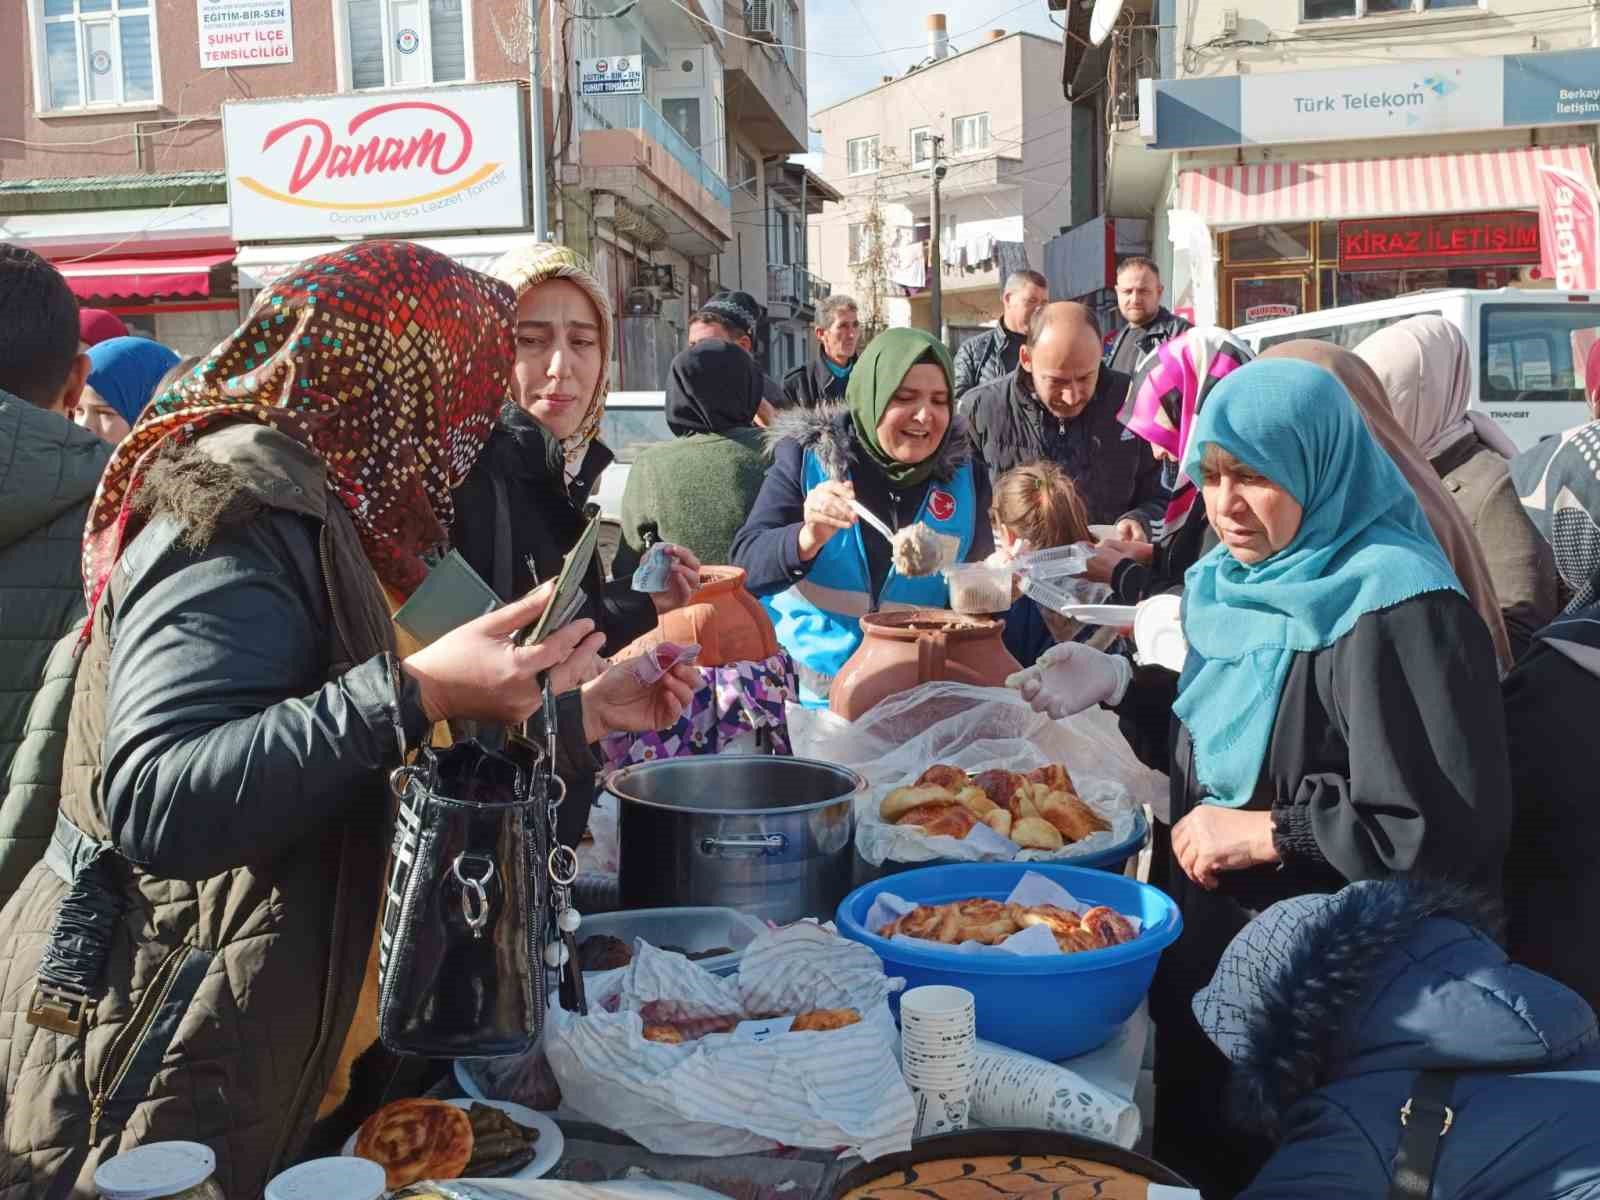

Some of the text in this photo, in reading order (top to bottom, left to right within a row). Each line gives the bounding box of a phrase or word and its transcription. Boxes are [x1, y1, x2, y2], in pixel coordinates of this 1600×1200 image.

[207, 28, 285, 48] ŞUHUT İLÇE
[205, 43, 289, 62] TEMSİLCİLİĞİ
[1294, 91, 1424, 112] Türk Telekom
[1559, 89, 1600, 101] Berkay
[1556, 101, 1600, 114] İletişim
[262, 101, 474, 195] Danam
[328, 211, 377, 224] Danam
[422, 193, 463, 214] Lezzet
[1345, 223, 1538, 255] KİRAZ İLETİŞİM
